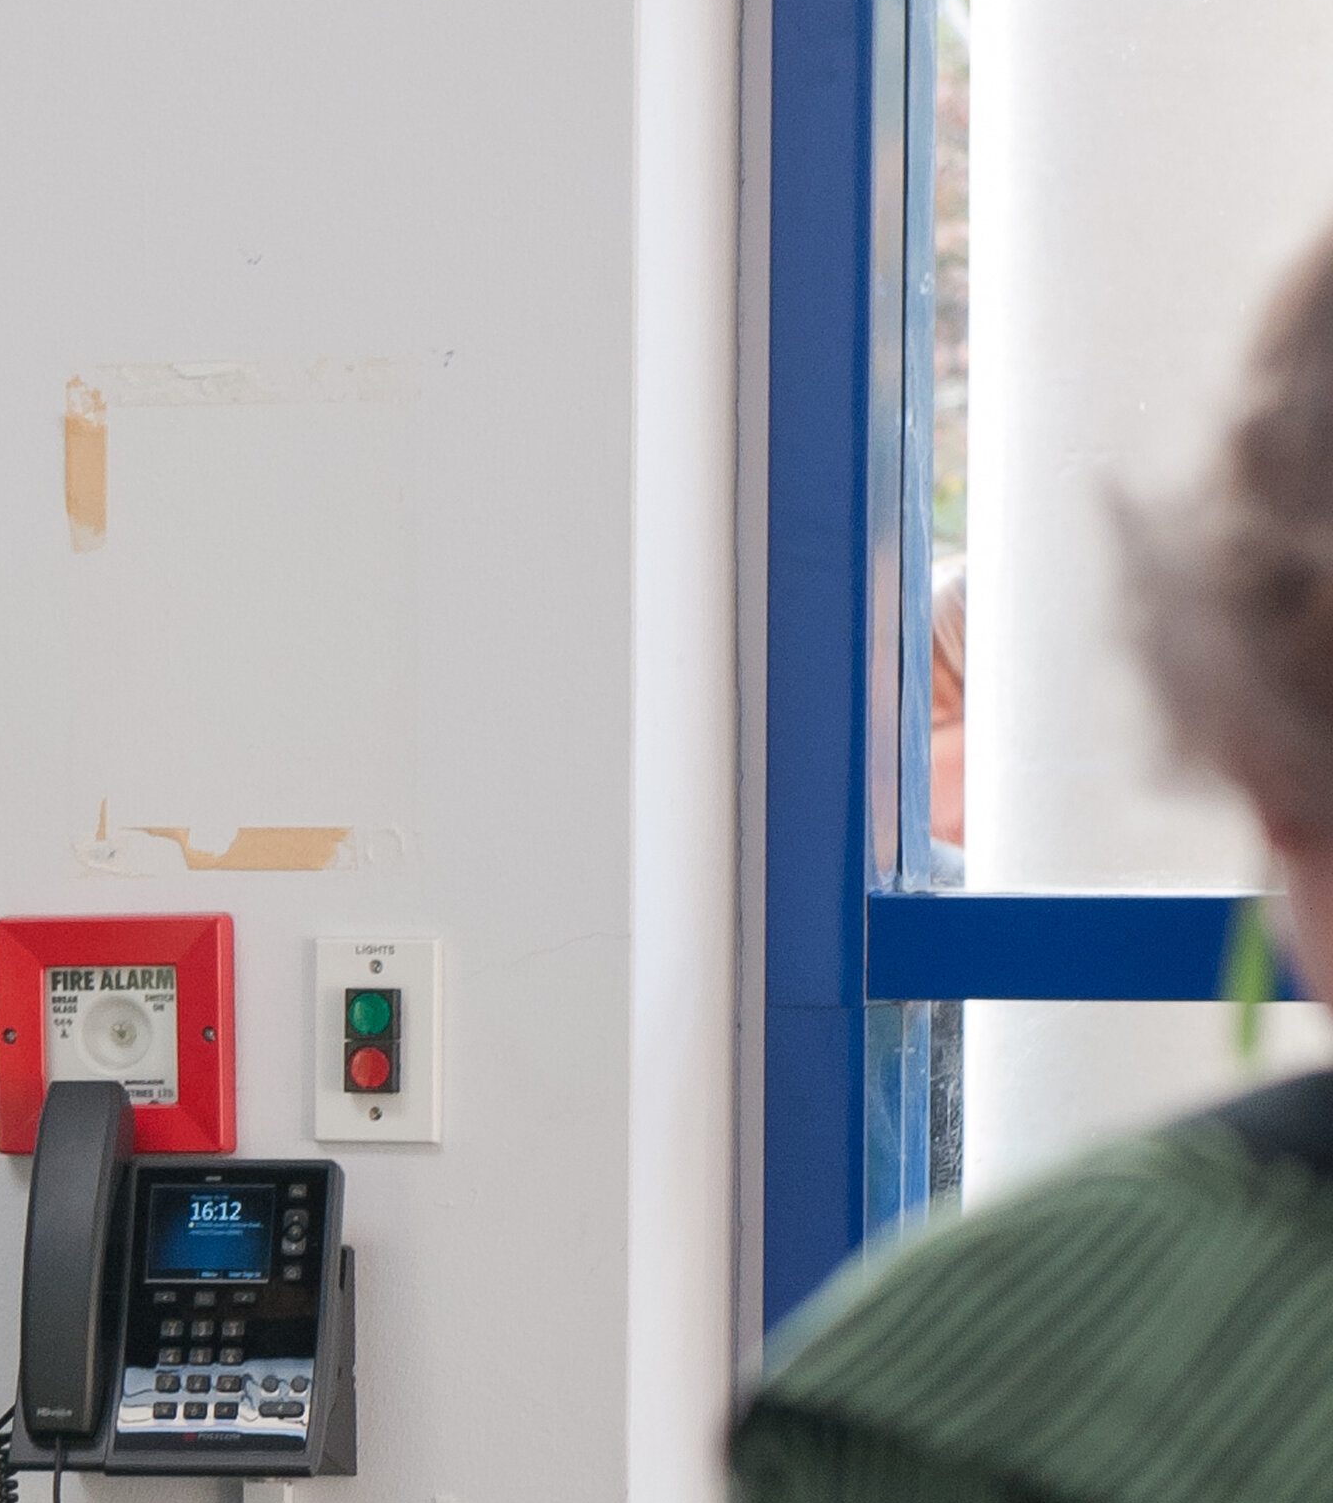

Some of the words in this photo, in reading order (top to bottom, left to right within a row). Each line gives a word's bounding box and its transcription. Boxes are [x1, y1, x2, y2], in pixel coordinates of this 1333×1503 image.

[355, 944, 395, 955] LIGHTS
[51, 970, 95, 991] FIRE
[100, 968, 174, 990] ALARM
[190, 1201, 242, 1221] 16:12
